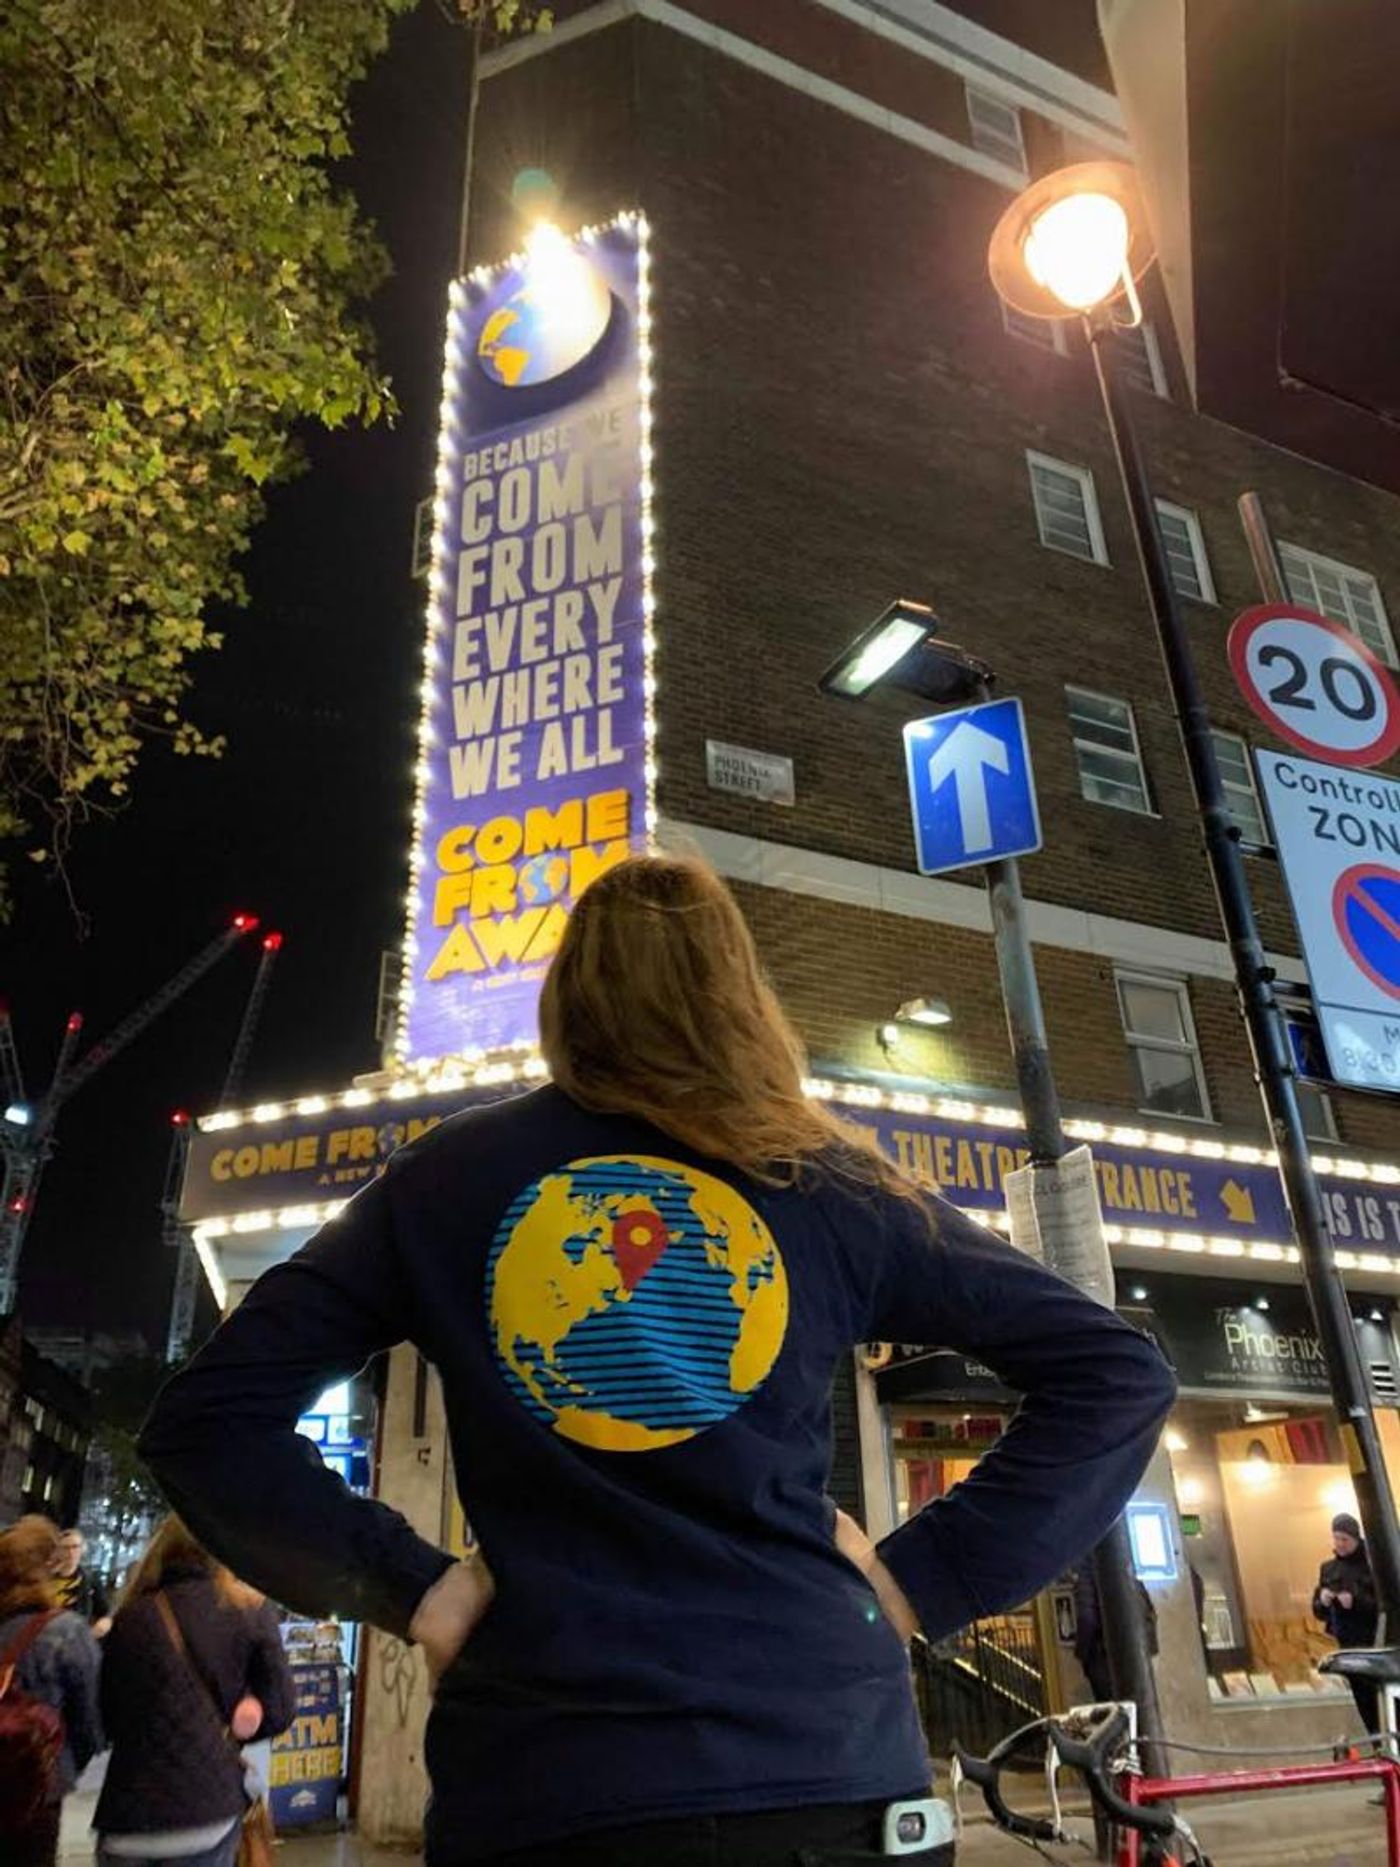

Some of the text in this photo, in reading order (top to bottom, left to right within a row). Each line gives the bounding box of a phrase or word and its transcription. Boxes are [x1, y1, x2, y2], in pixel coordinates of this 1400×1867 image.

[463, 425, 571, 482] BECAUSE
[455, 503, 624, 617] FROM
[452, 577, 625, 683] EVERY
[451, 644, 624, 742] WHERE
[1257, 643, 1377, 722] 20
[448, 708, 625, 801] WE ALL
[435, 788, 630, 874] COME
[423, 903, 569, 983] AWA
[210, 1136, 321, 1182] COME
[892, 1131, 1031, 1192] THEATR
[1355, 1196, 1385, 1240] IS
[1224, 1323, 1325, 1361] Phoenix
[272, 1713, 338, 1750] ATM
